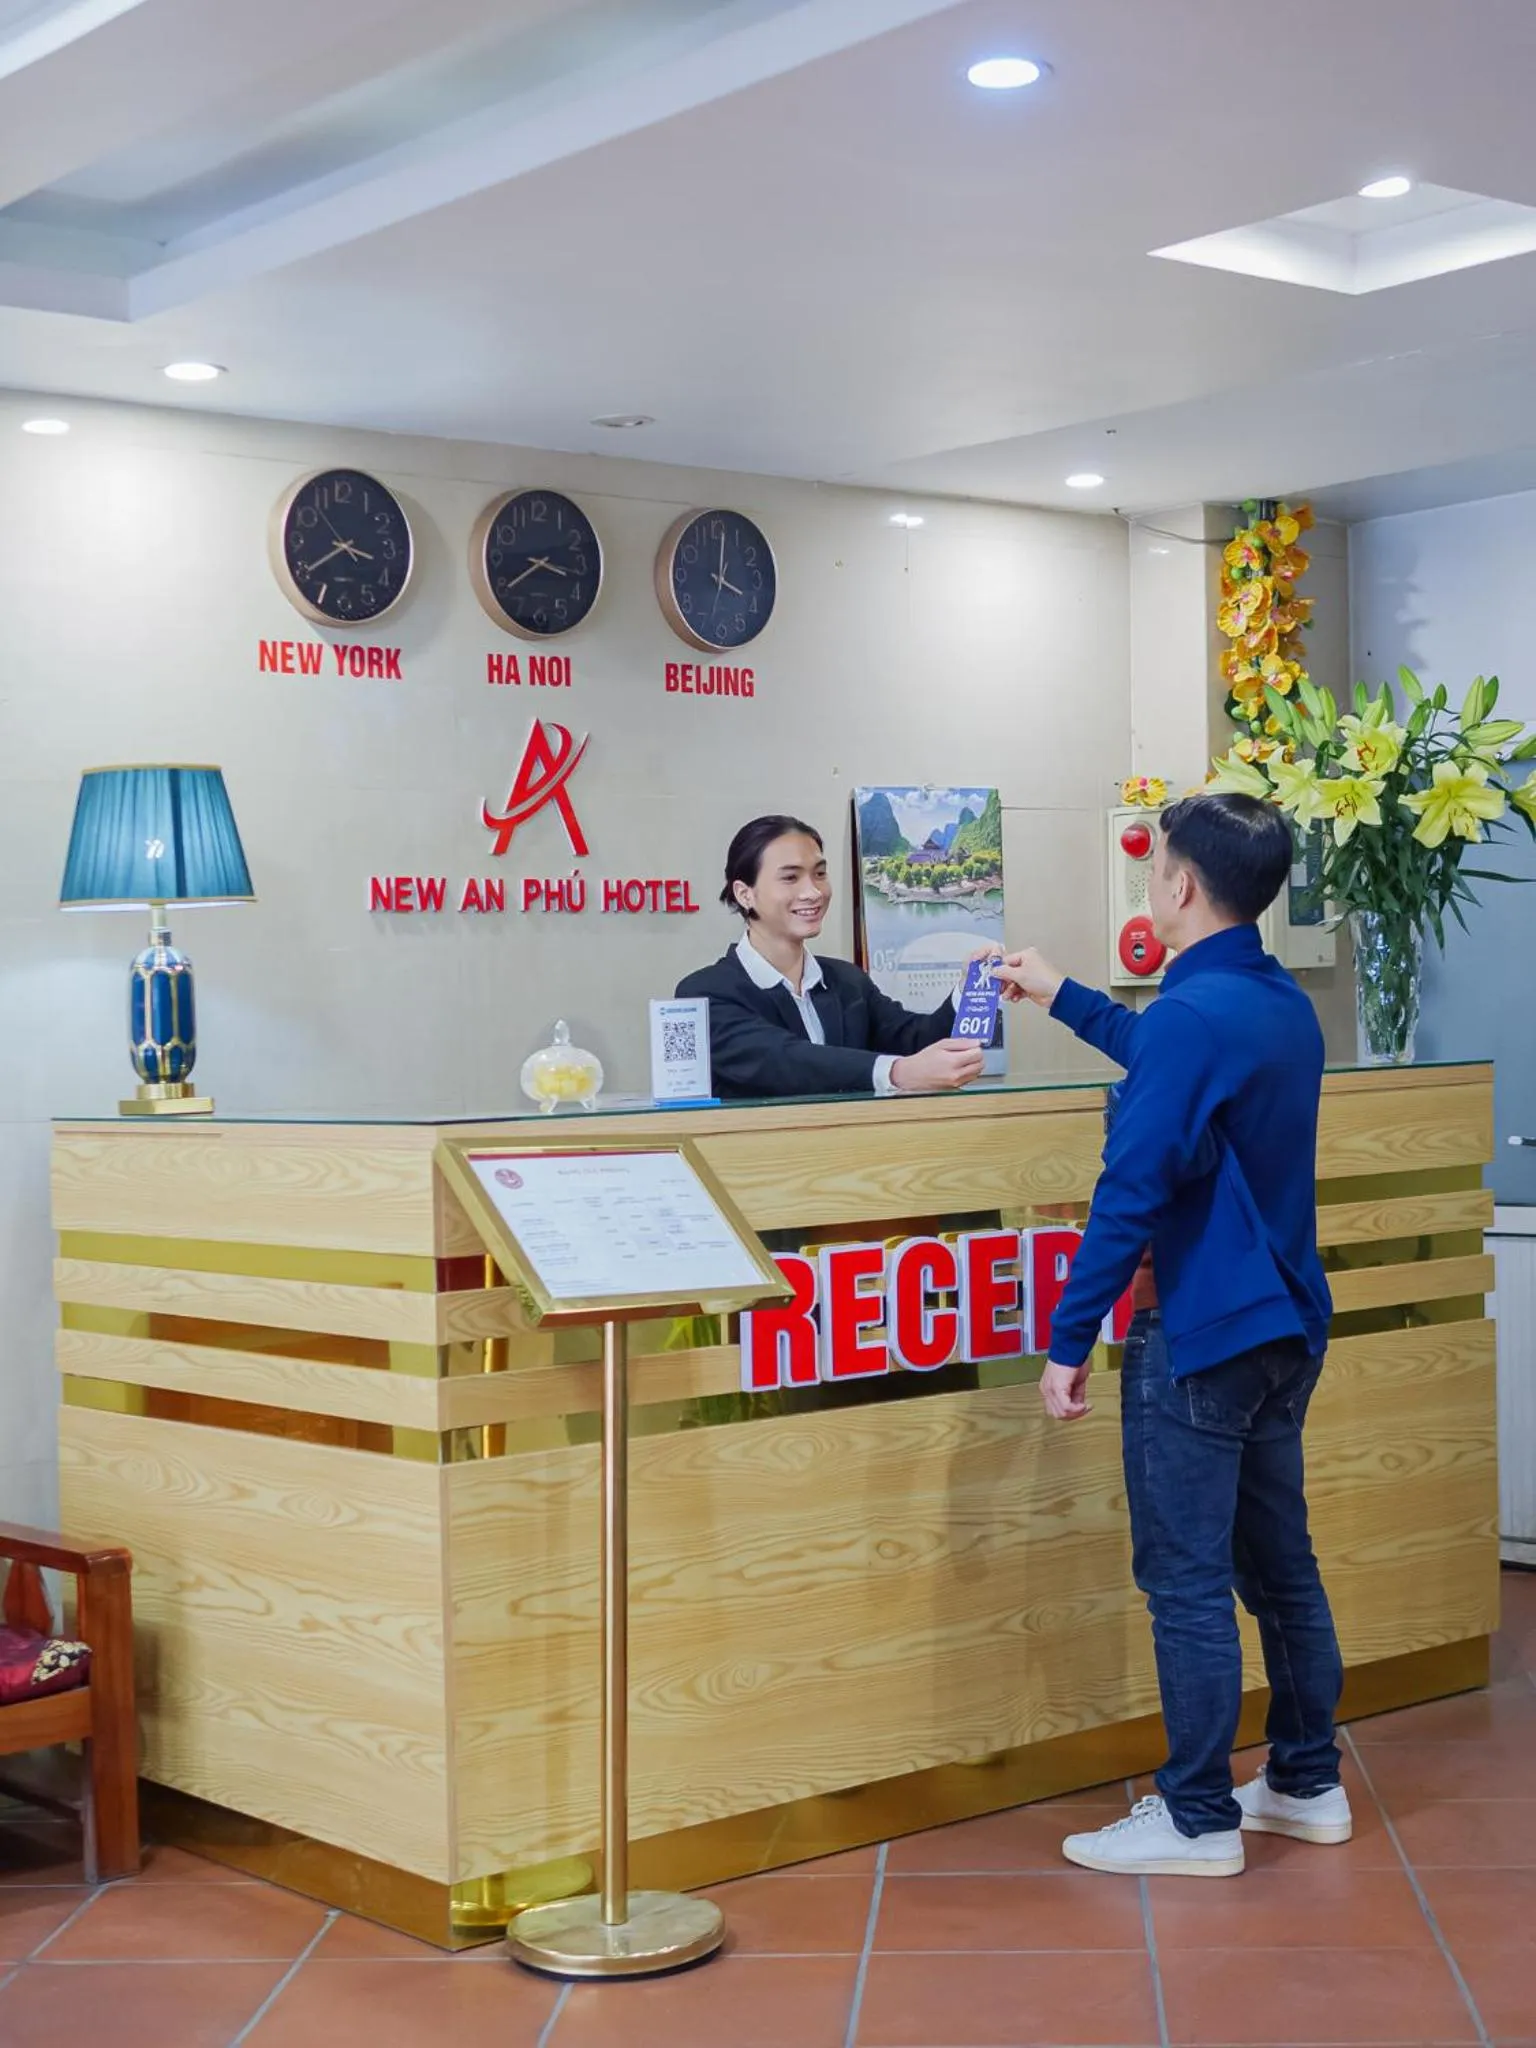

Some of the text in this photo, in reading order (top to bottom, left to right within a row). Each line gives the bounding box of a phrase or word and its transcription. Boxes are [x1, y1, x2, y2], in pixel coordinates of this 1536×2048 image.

[530, 501, 548, 522] 12
[376, 512, 391, 534] 2
[383, 538, 396, 560] 3
[568, 529, 582, 551] 2
[744, 546, 758, 567] 2
[361, 584, 376, 606] 5
[554, 598, 569, 620] 5
[258, 640, 402, 680] NEW YORK
[487, 654, 572, 687] HA NOI
[665, 663, 755, 697] BEIJING
[369, 869, 700, 912] NEW AN PHÚ HOTEL
[873, 949, 897, 973] 05
[959, 1016, 991, 1035] 601
